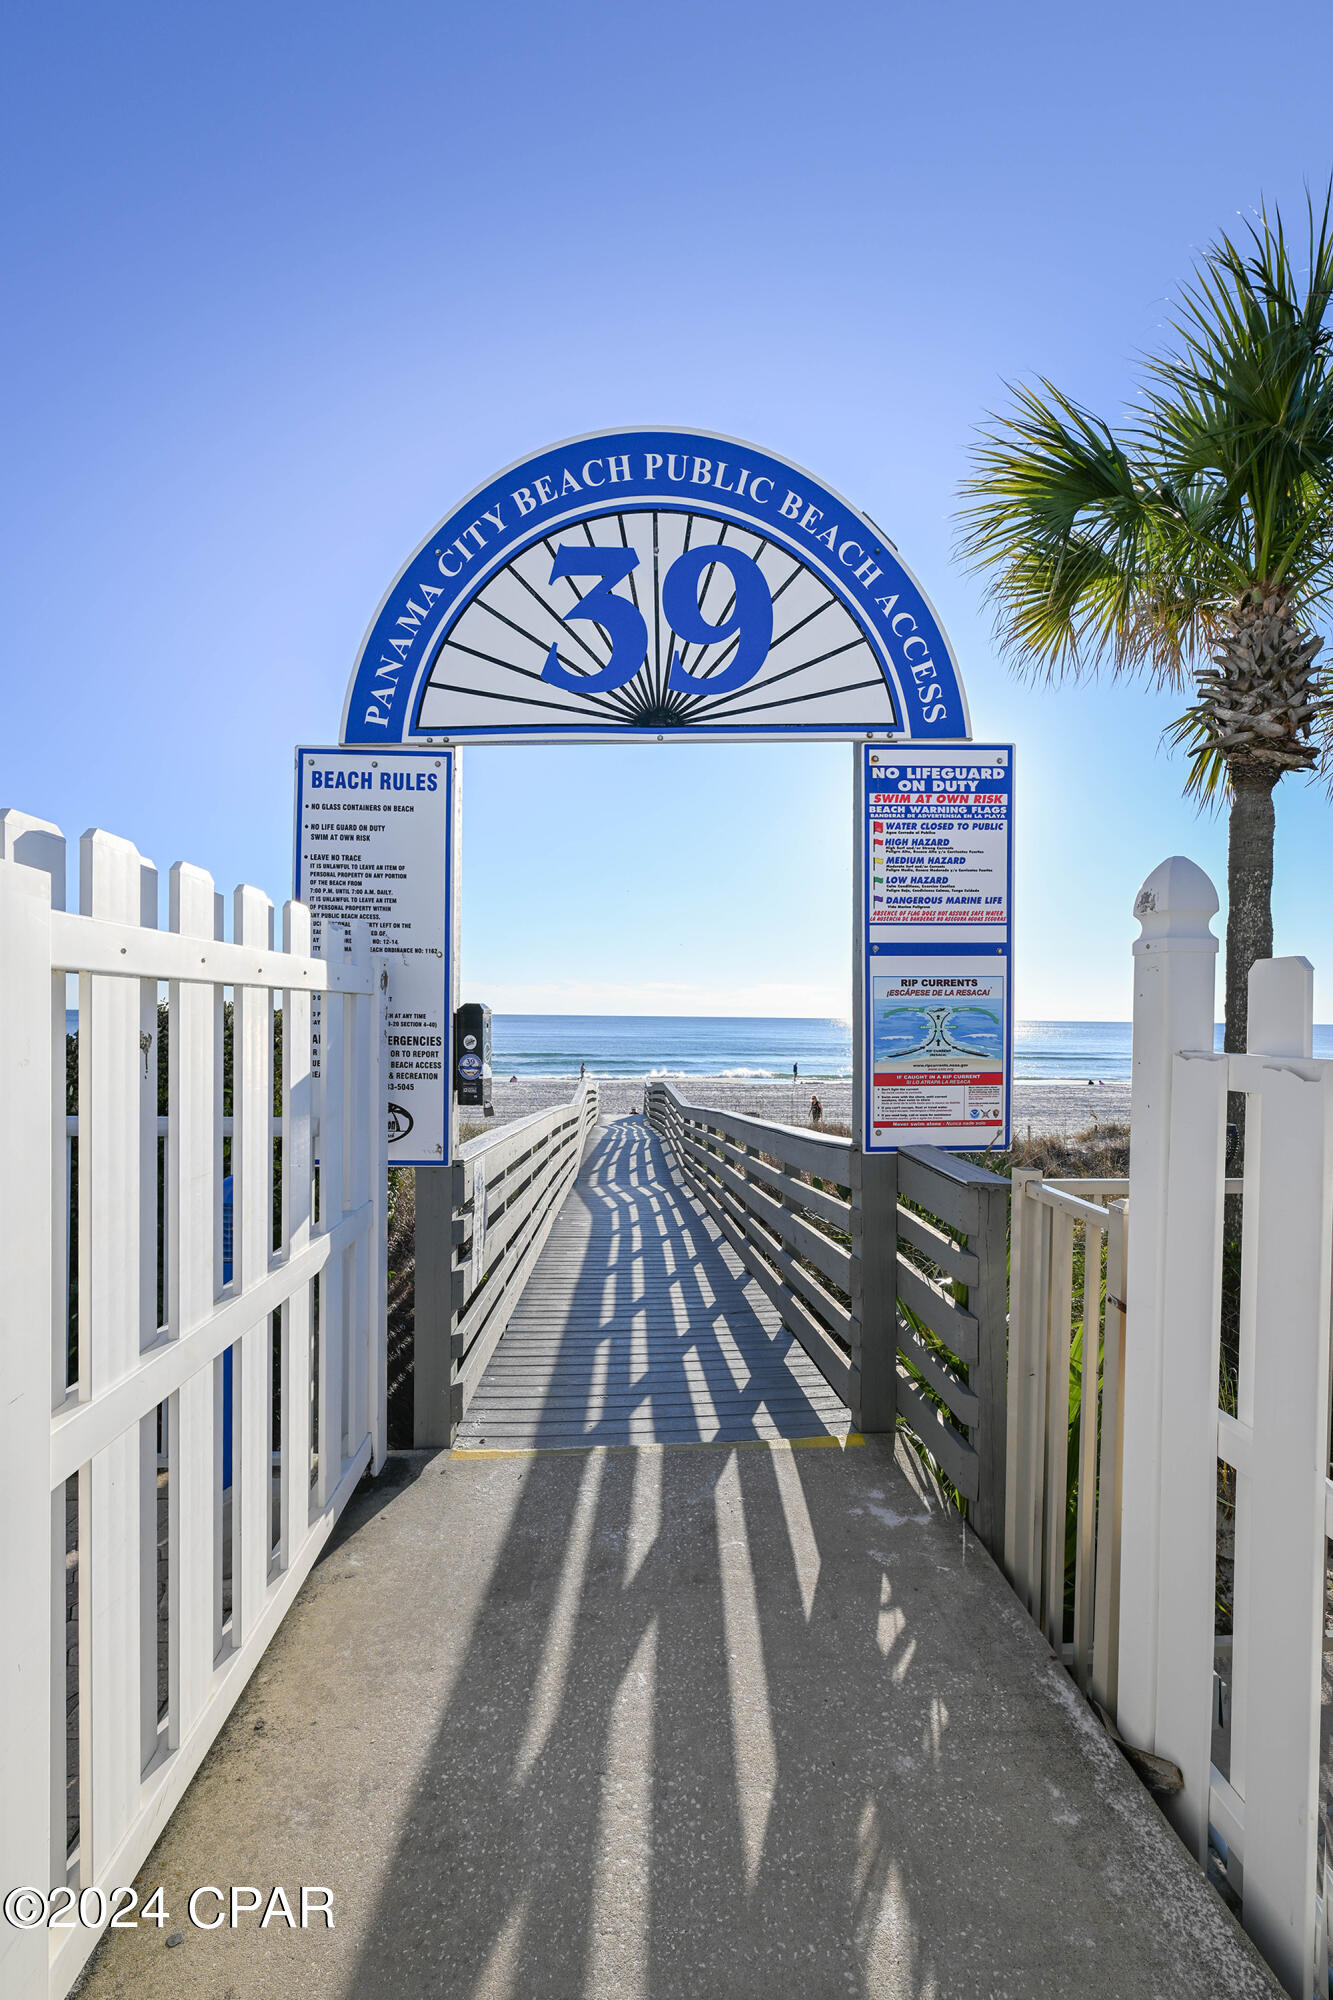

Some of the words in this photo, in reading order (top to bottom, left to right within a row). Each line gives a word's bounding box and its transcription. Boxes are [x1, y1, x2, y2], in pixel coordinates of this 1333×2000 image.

[365, 584, 444, 727] PANAMA
[439, 504, 506, 576] CITY
[511, 455, 632, 516] BEACH
[645, 454, 774, 503] PUBLIC
[778, 490, 883, 589] BEACH
[875, 595, 946, 722] ACCESS
[540, 544, 773, 695] 39
[873, 768, 899, 778] NO
[907, 768, 1004, 779] LIFEGUARD
[312, 771, 372, 790] BEACH
[380, 772, 437, 791] RULES
[898, 780, 925, 791] ON
[933, 780, 978, 792] DUTY
[874, 795, 910, 803] SWIM
[916, 795, 932, 803] AT
[937, 795, 969, 803] OWN
[974, 795, 1002, 803] RISK
[388, 1036, 441, 1046] ERGENCIES
